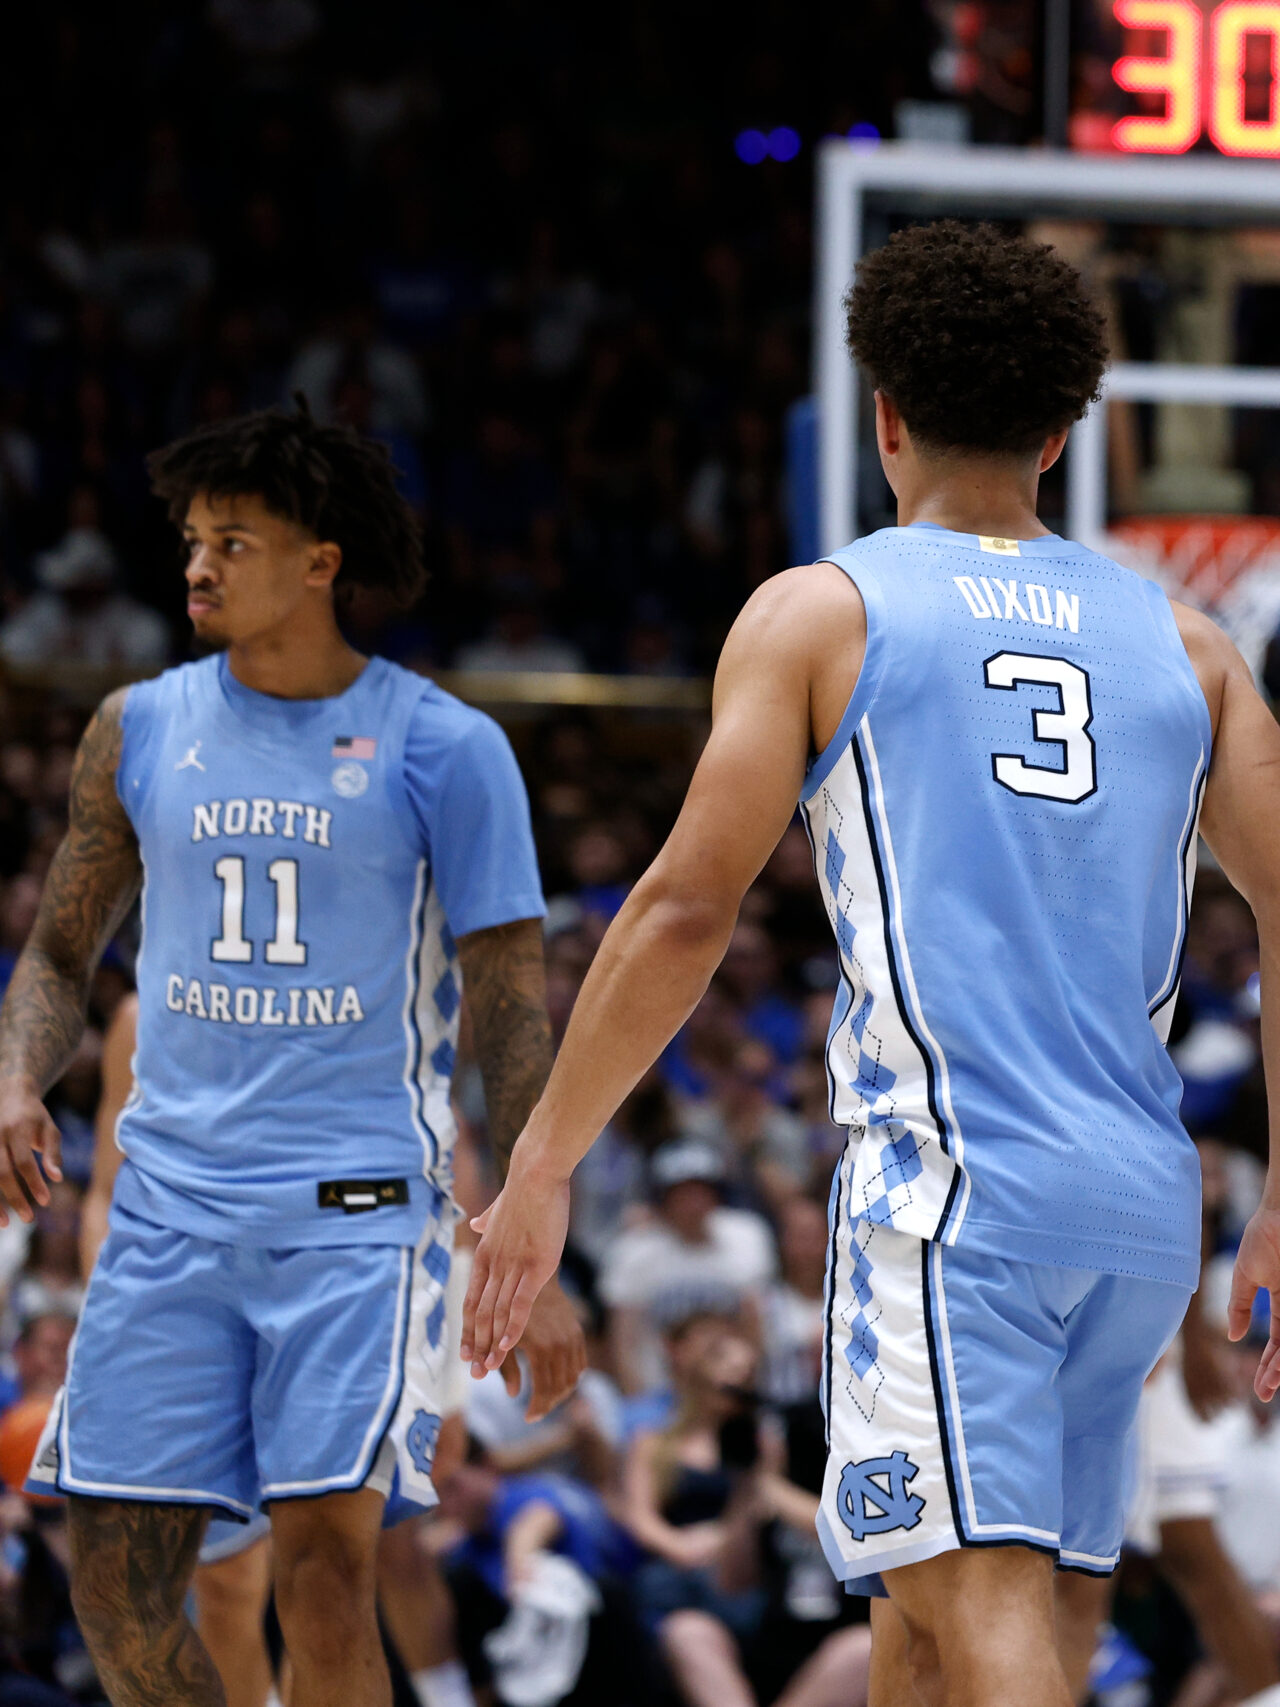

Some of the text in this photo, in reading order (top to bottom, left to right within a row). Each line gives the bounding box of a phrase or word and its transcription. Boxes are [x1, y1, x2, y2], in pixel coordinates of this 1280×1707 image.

[952, 576, 1080, 634] DIXON
[983, 650, 1098, 805] 3
[191, 798, 333, 849] NORTH
[210, 854, 308, 966] 11
[165, 972, 365, 1026] CAROLINA
